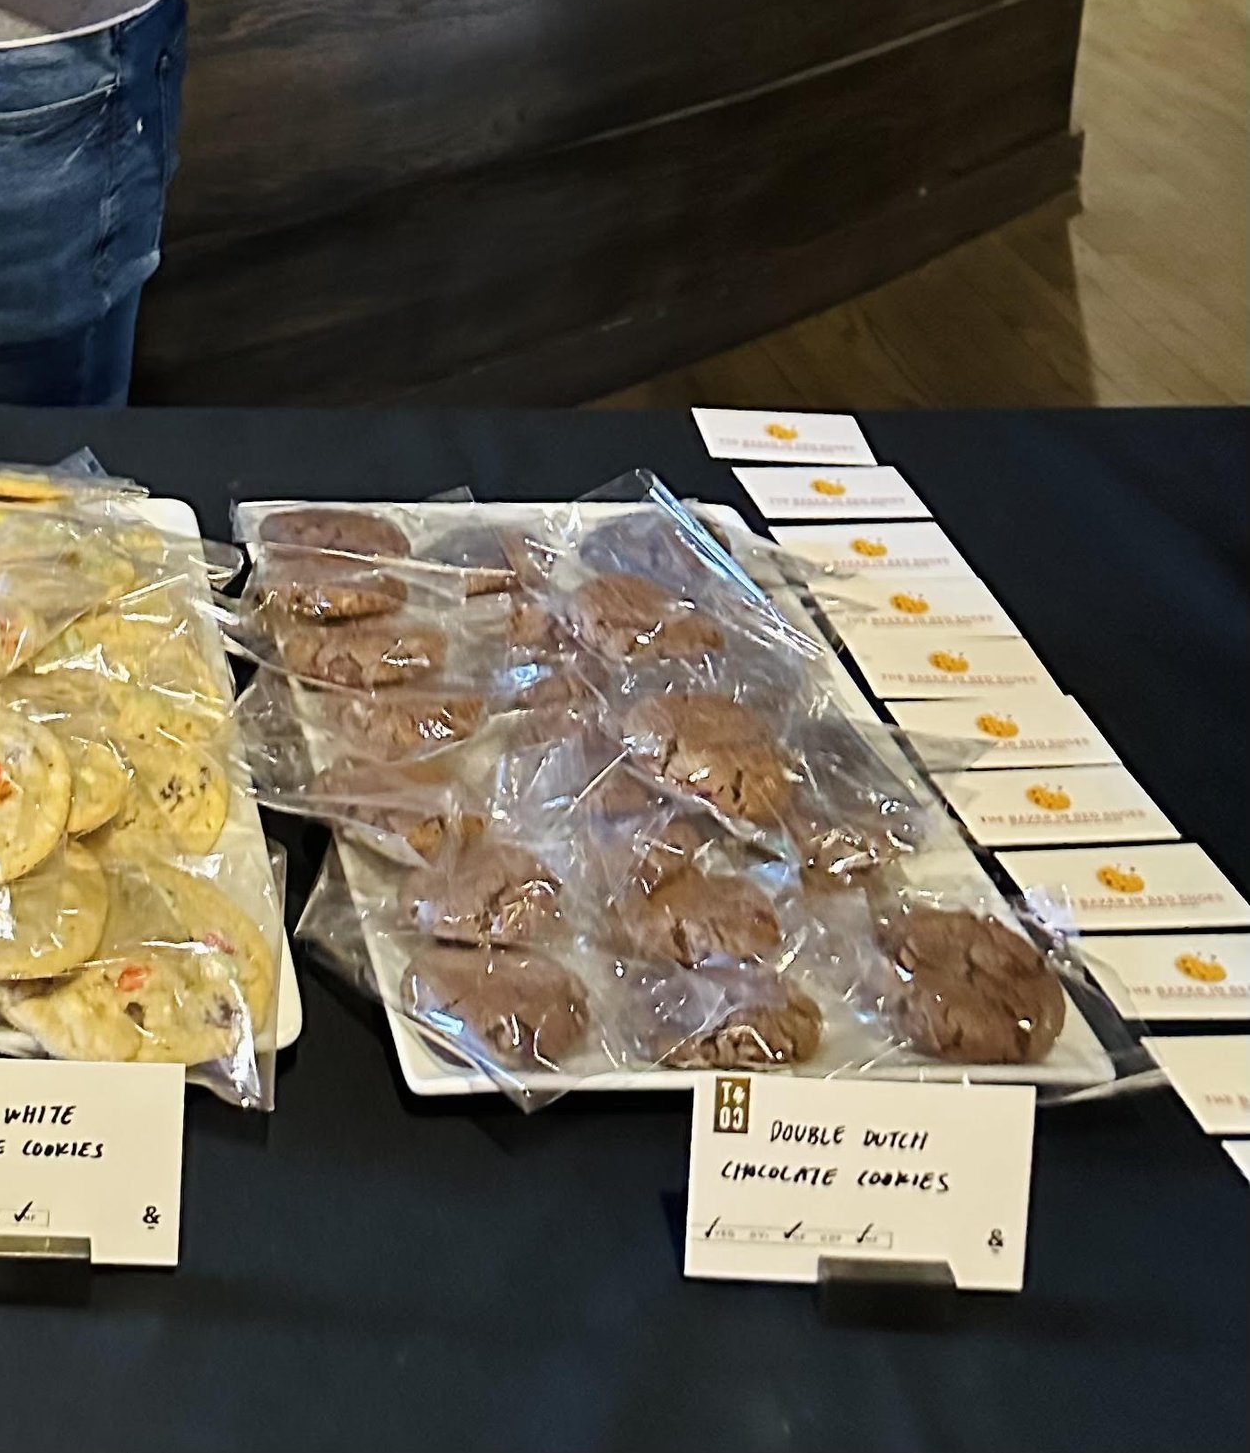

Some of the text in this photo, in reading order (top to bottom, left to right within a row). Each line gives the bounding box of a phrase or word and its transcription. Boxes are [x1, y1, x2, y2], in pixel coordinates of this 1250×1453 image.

[4, 1105, 77, 1125] WHITE
[770, 1119, 928, 1151] DOUBLE DUTCH
[22, 1139, 104, 1159] COOKIES
[721, 1160, 950, 1193] CHOCOLATE COOKIES
